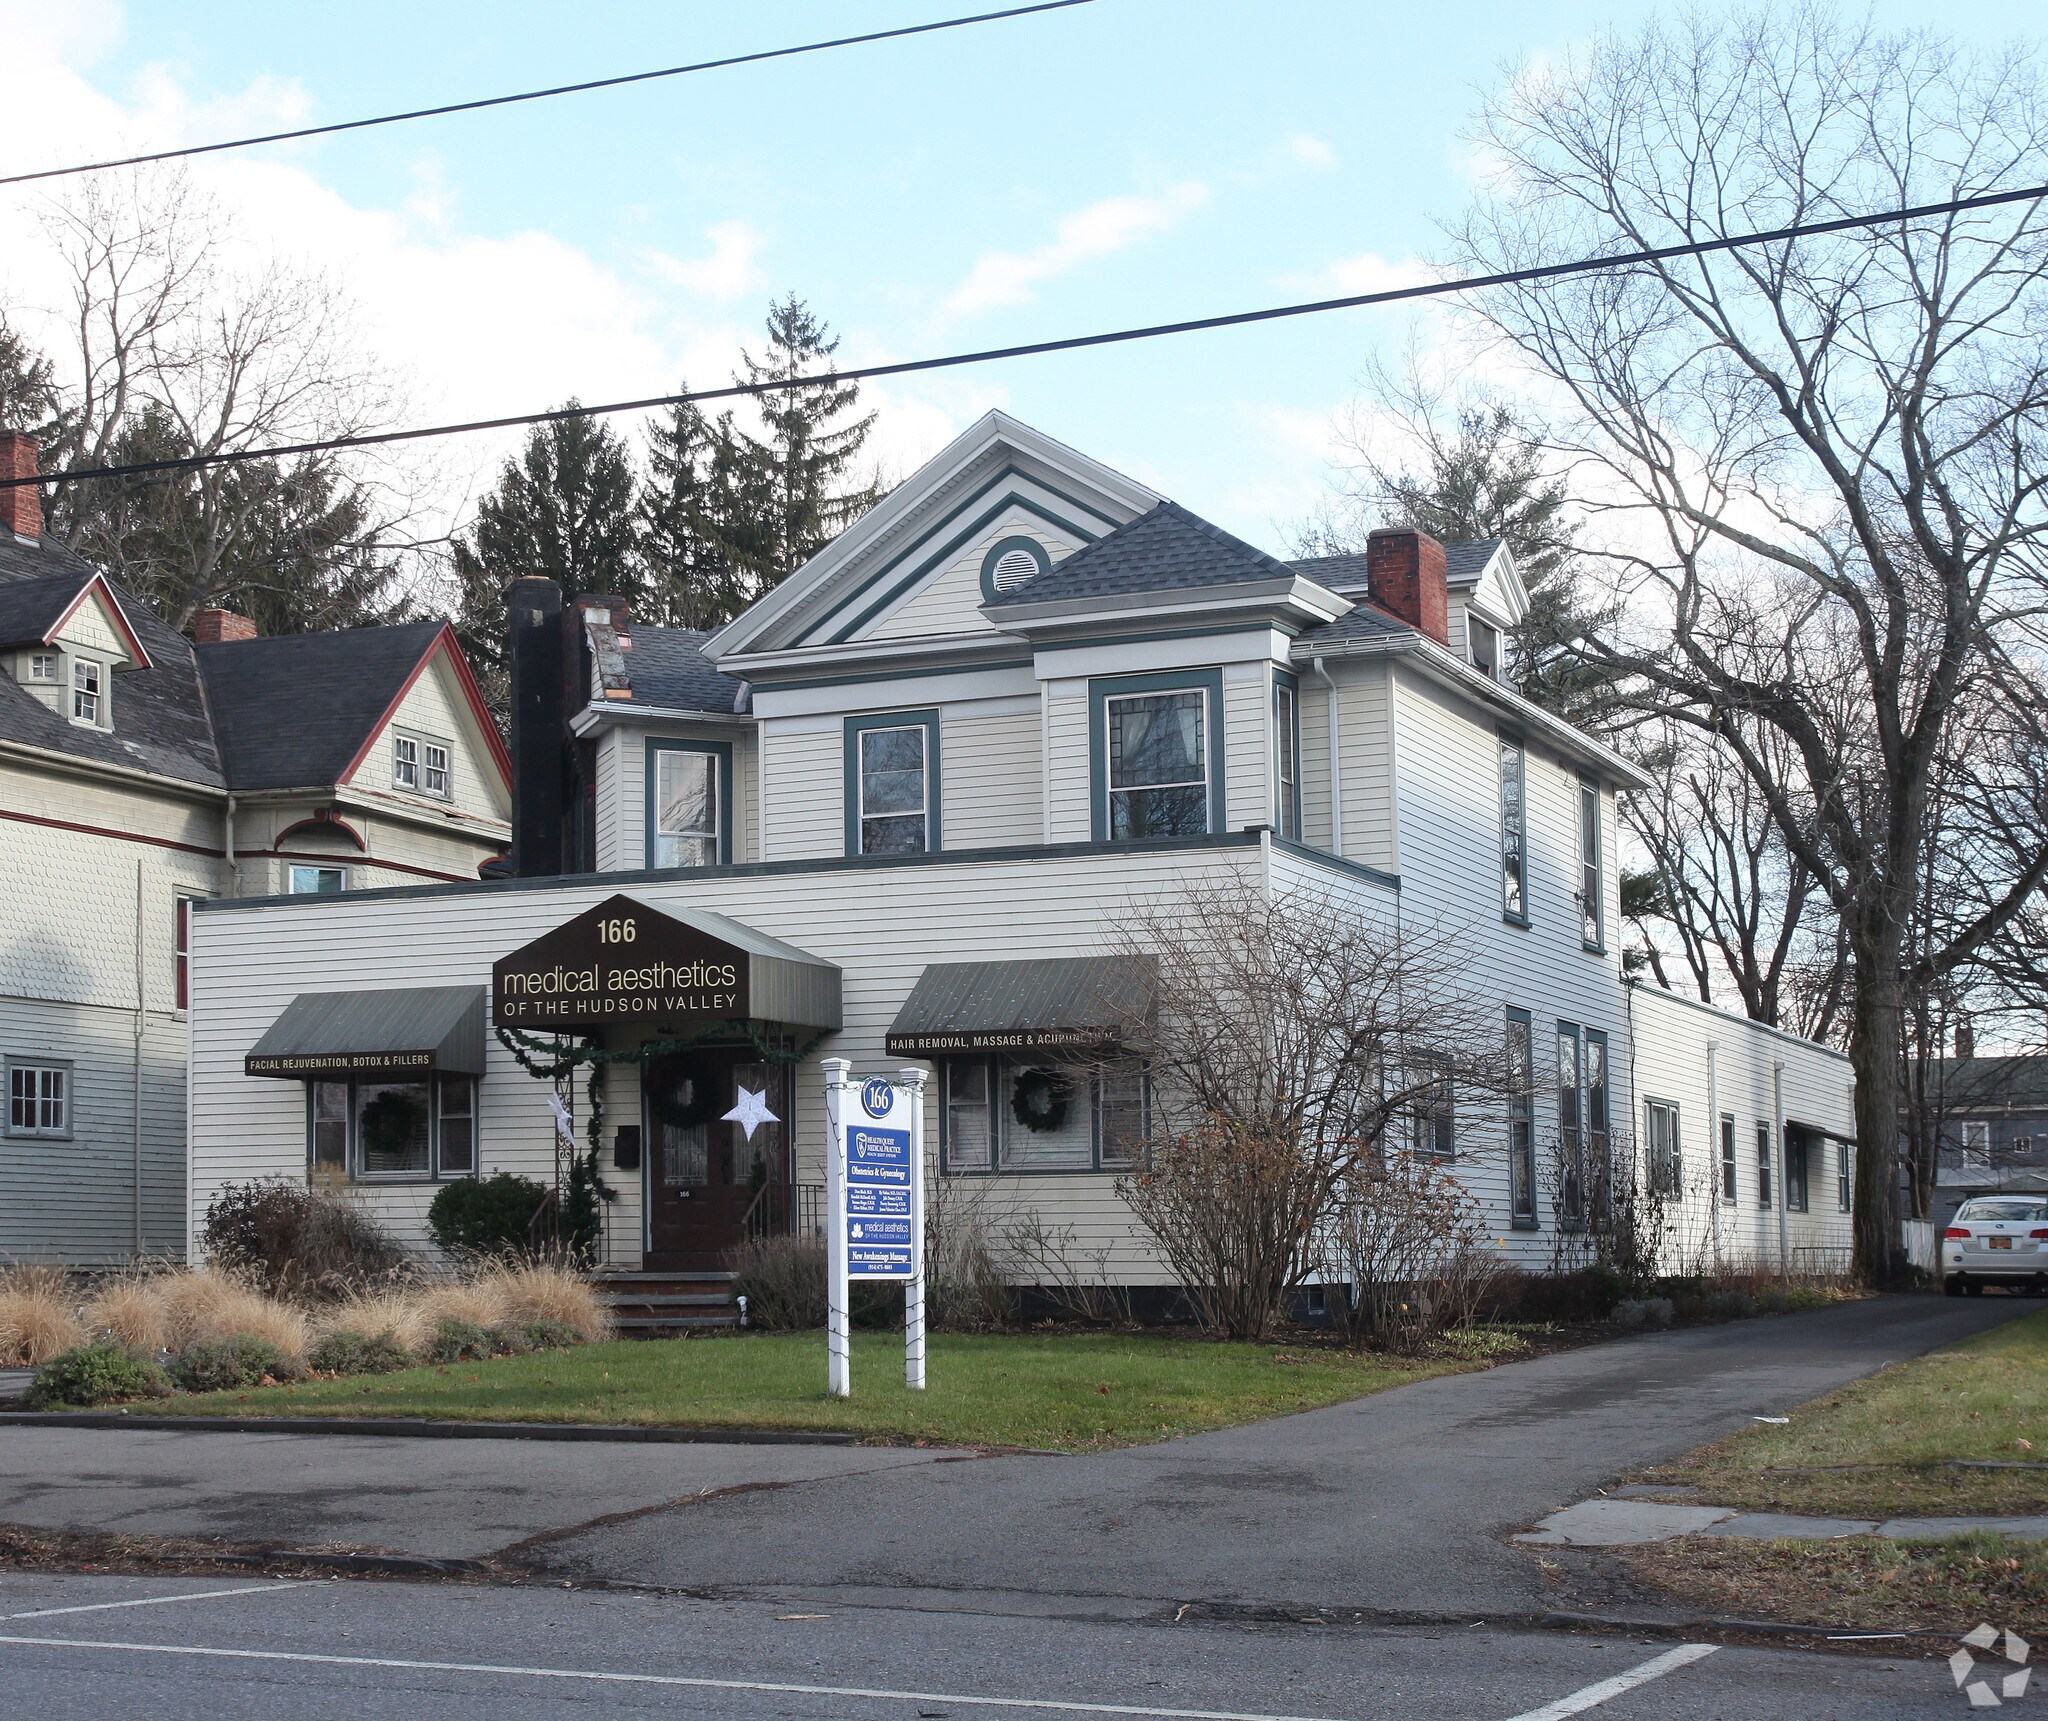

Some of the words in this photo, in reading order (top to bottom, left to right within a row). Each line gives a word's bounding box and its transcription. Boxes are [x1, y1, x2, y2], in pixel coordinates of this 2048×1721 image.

[597, 918, 636, 944] 166
[504, 964, 599, 995] medical
[608, 959, 736, 991] aesthetics
[504, 1002, 528, 1017] OF
[536, 1001, 569, 1016] THE
[577, 997, 658, 1014] HUDSON
[665, 994, 737, 1011] VALLEY
[890, 1039, 915, 1050] HAIR
[919, 1036, 969, 1049] REMOVAL,
[973, 1035, 1023, 1047] MASSAGE
[1026, 1034, 1034, 1045] &
[250, 1060, 280, 1070] FACIAL
[283, 1057, 351, 1069] REJUVENATION,
[353, 1056, 382, 1067] BOTOX
[384, 1056, 391, 1066] &
[393, 1054, 430, 1065] FILLERS
[870, 1086, 889, 1109] 166
[875, 1168, 880, 1176] &
[880, 1168, 906, 1180] Gynecology
[864, 1222, 884, 1232] medical
[885, 1223, 908, 1233] aesthetics
[852, 1251, 863, 1260] New
[863, 1251, 889, 1263] Awakenings
[889, 1251, 908, 1263] Massage
